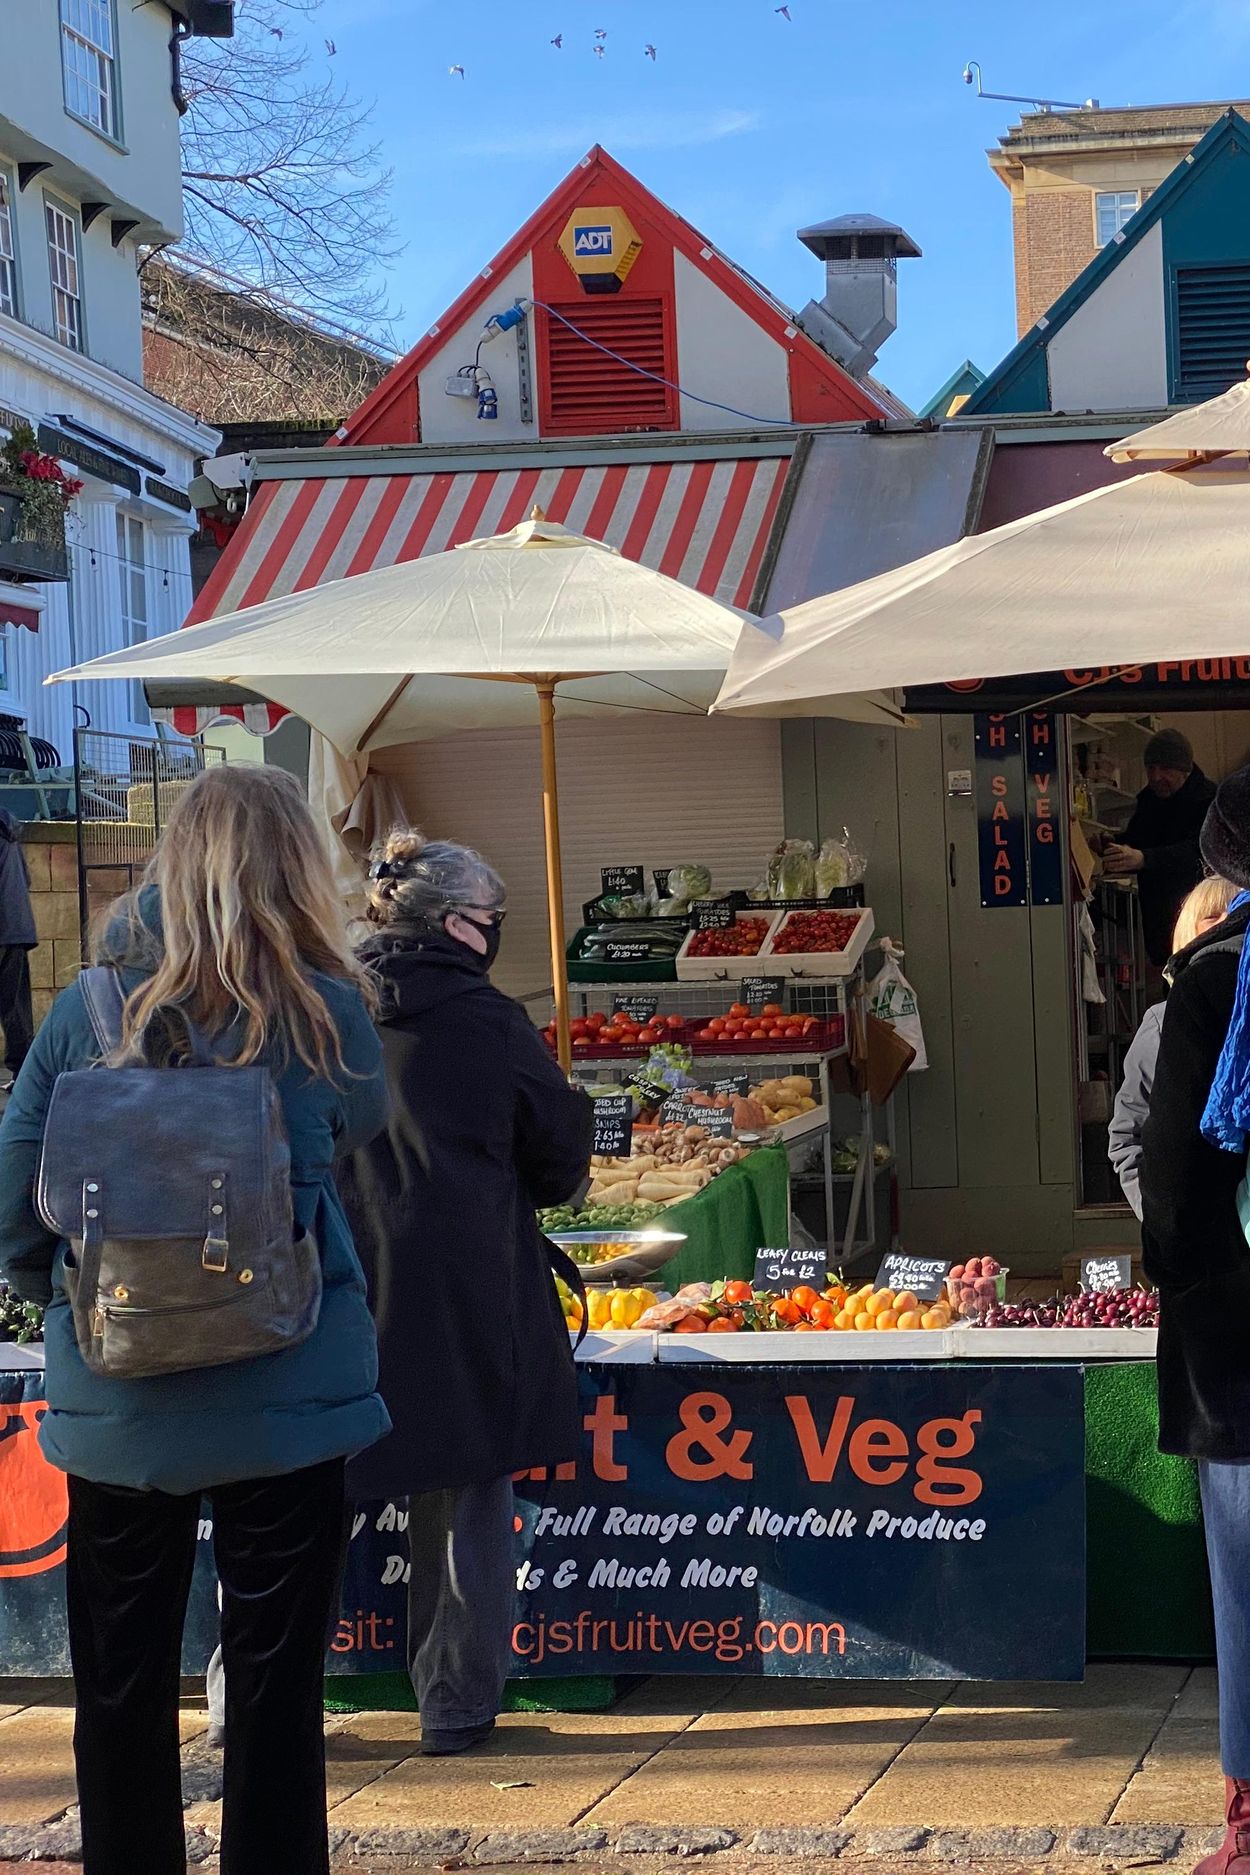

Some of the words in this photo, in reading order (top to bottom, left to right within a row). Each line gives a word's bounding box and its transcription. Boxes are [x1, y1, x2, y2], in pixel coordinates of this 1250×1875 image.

[576, 232, 611, 251] ADT
[1034, 774, 1054, 843] VEG
[991, 776, 1012, 895] SALAD
[628, 1074, 654, 1089] CRISPY
[688, 1107, 726, 1119] CHESTNUT
[757, 1248, 788, 1264] LEAFY
[884, 1255, 946, 1273] APRICOTS
[766, 1264, 781, 1280] 5
[799, 1264, 816, 1280] £2
[1086, 1260, 1118, 1275] Cherries
[666, 1391, 753, 1482] &
[785, 1395, 983, 1506] Veg
[534, 1506, 597, 1538] Full
[603, 1508, 694, 1544] Range
[707, 1506, 744, 1536] of
[748, 1507, 857, 1539] Norfolk
[865, 1510, 986, 1542] Produce
[553, 1560, 577, 1588] &
[588, 1557, 671, 1589] Much
[681, 1559, 758, 1588] More
[511, 1610, 845, 1663] cjsfruitveg.com
